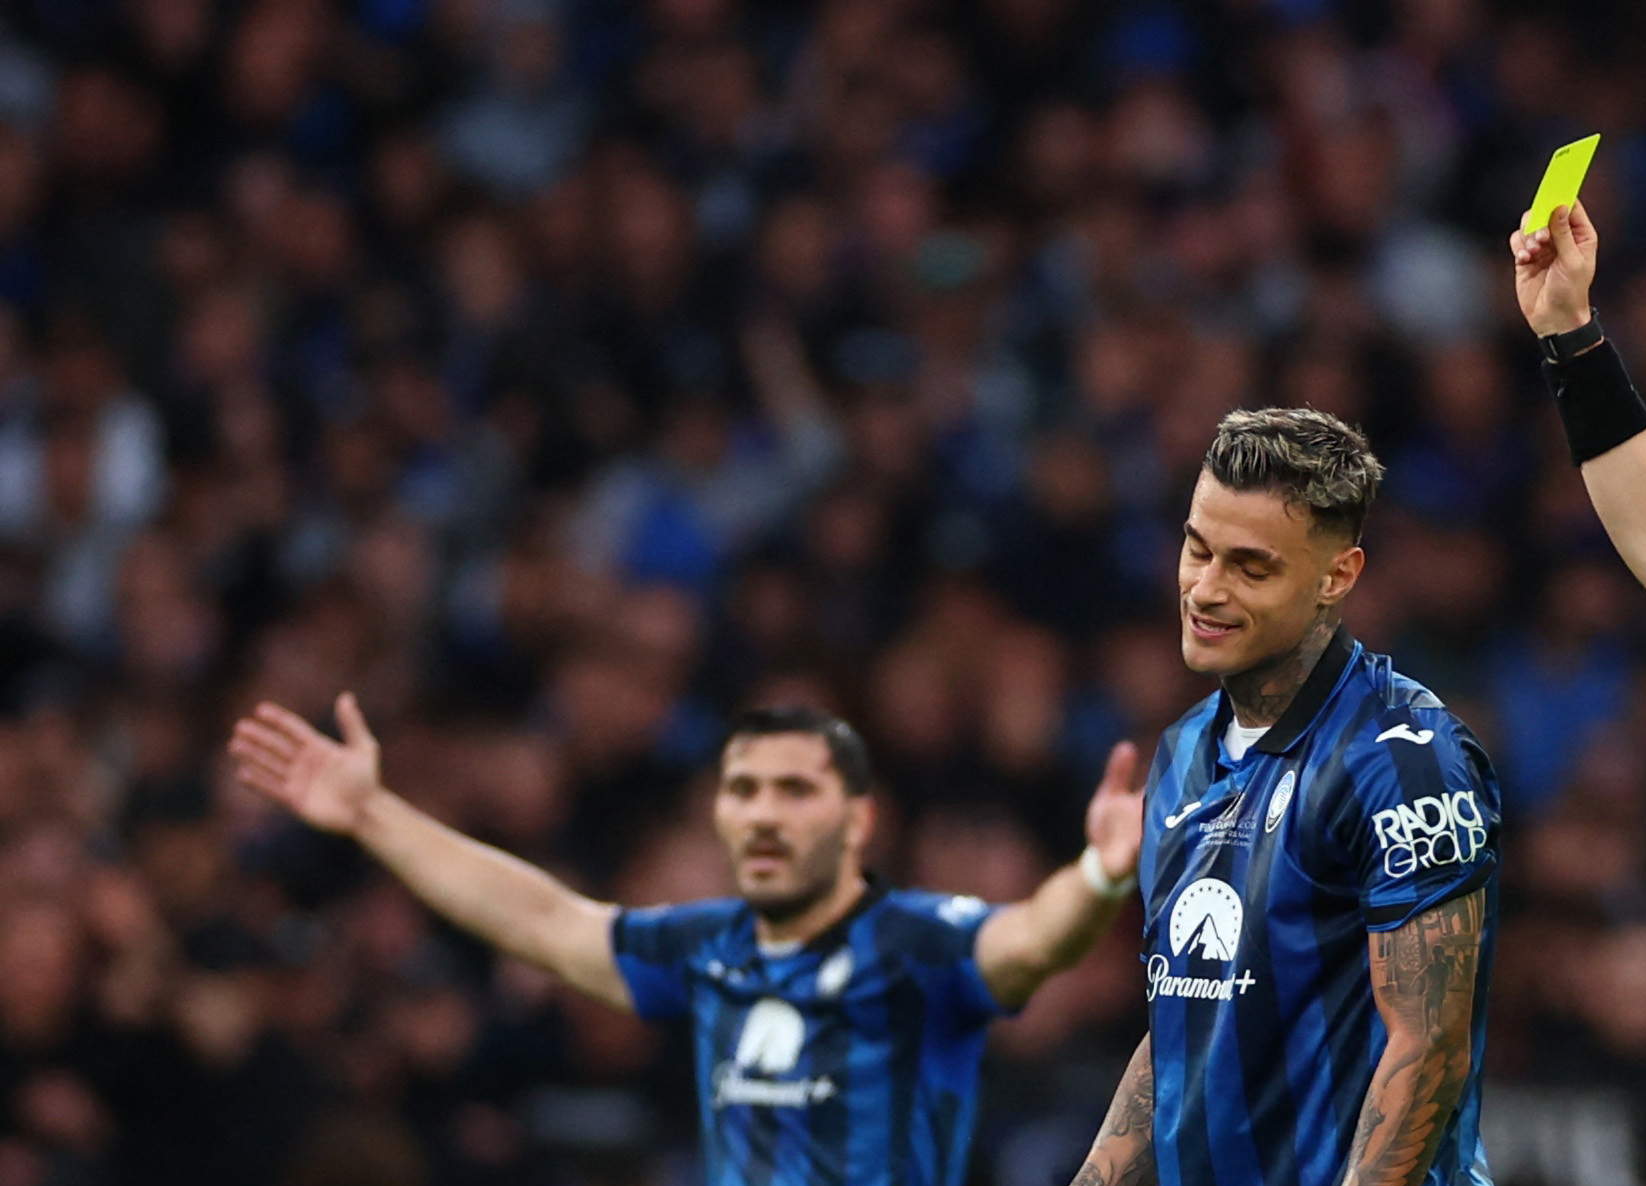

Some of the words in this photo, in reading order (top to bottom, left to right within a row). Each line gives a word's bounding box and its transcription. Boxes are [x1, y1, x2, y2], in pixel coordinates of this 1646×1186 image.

[1372, 790, 1483, 849] RADICI
[1384, 827, 1487, 878] GROUP
[1146, 954, 1256, 1002] Paramot+
